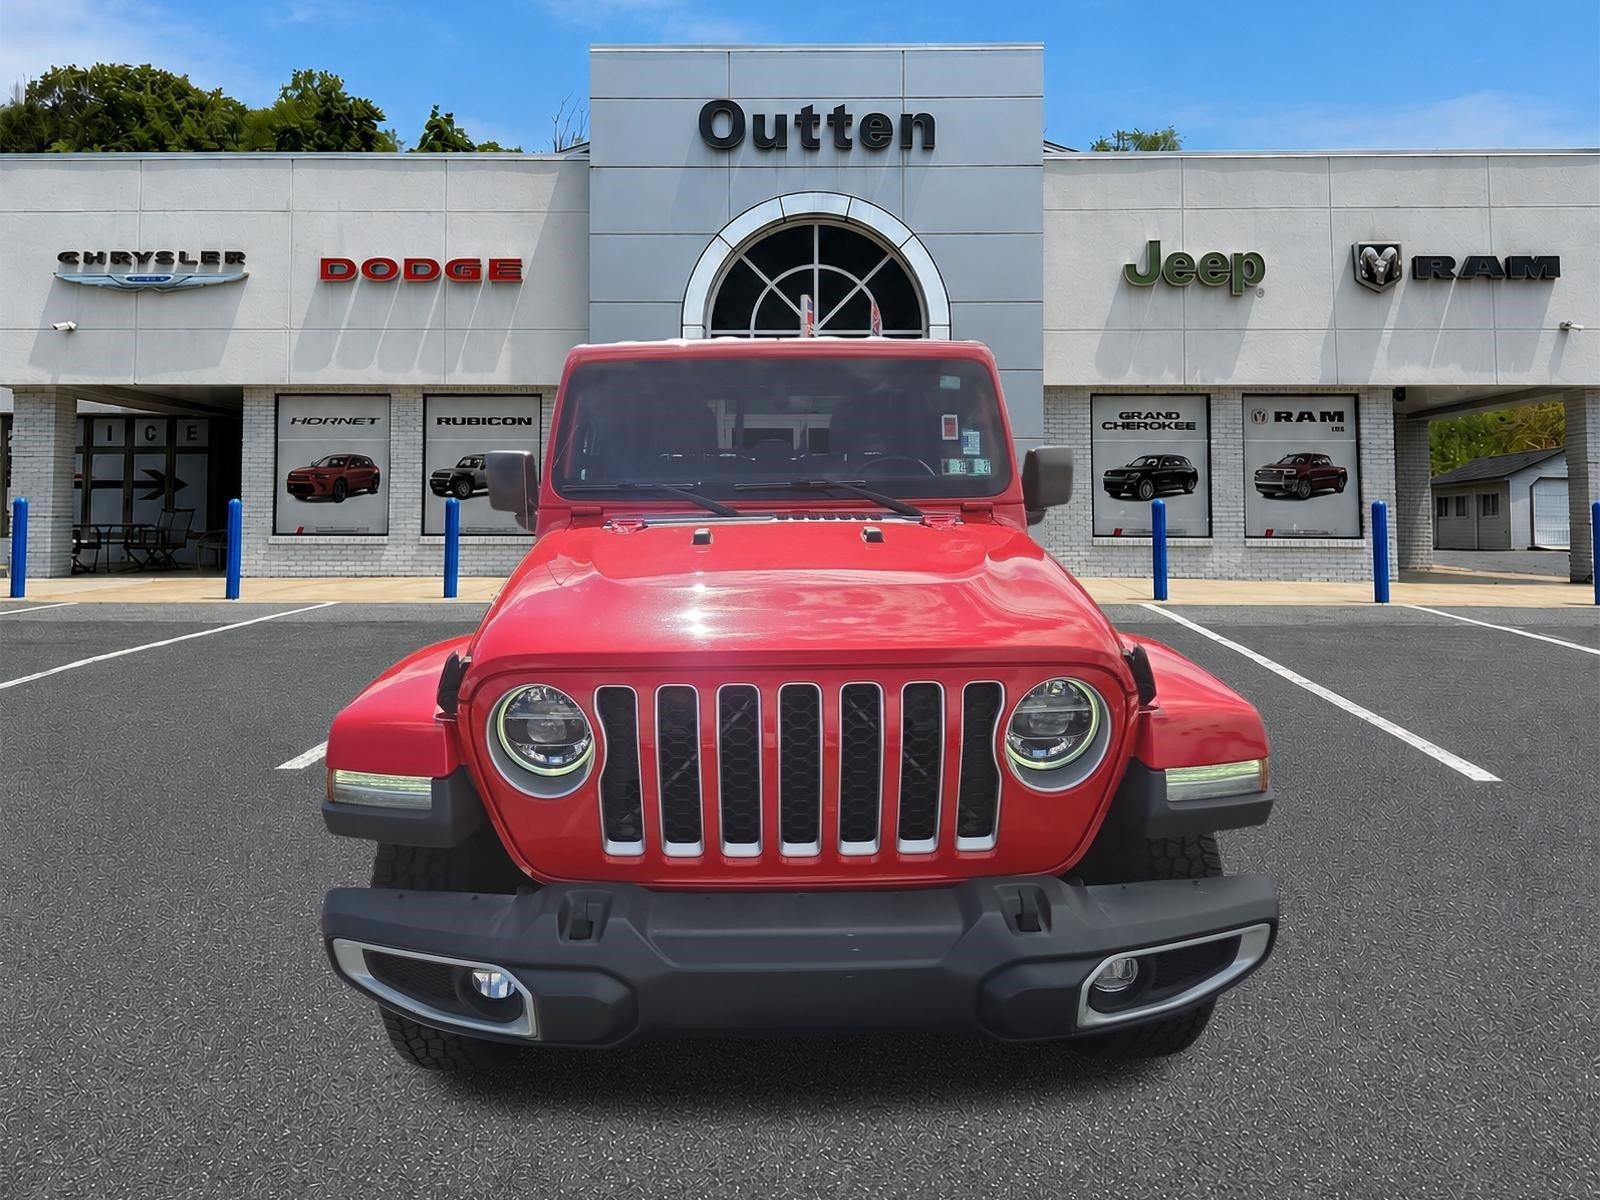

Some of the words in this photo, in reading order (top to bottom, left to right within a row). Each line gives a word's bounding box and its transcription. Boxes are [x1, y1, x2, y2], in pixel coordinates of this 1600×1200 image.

[699, 99, 936, 150] Outten
[57, 250, 247, 266] CHRYSLER
[319, 257, 524, 283] DODGE
[1123, 239, 1266, 297] Jeep
[1412, 254, 1562, 281] RAM
[290, 417, 381, 425] HORNET
[436, 416, 533, 426] RUBICON
[1118, 411, 1181, 420] GRAND
[1274, 410, 1345, 423] RAM
[1101, 421, 1197, 431] CHEROKEE
